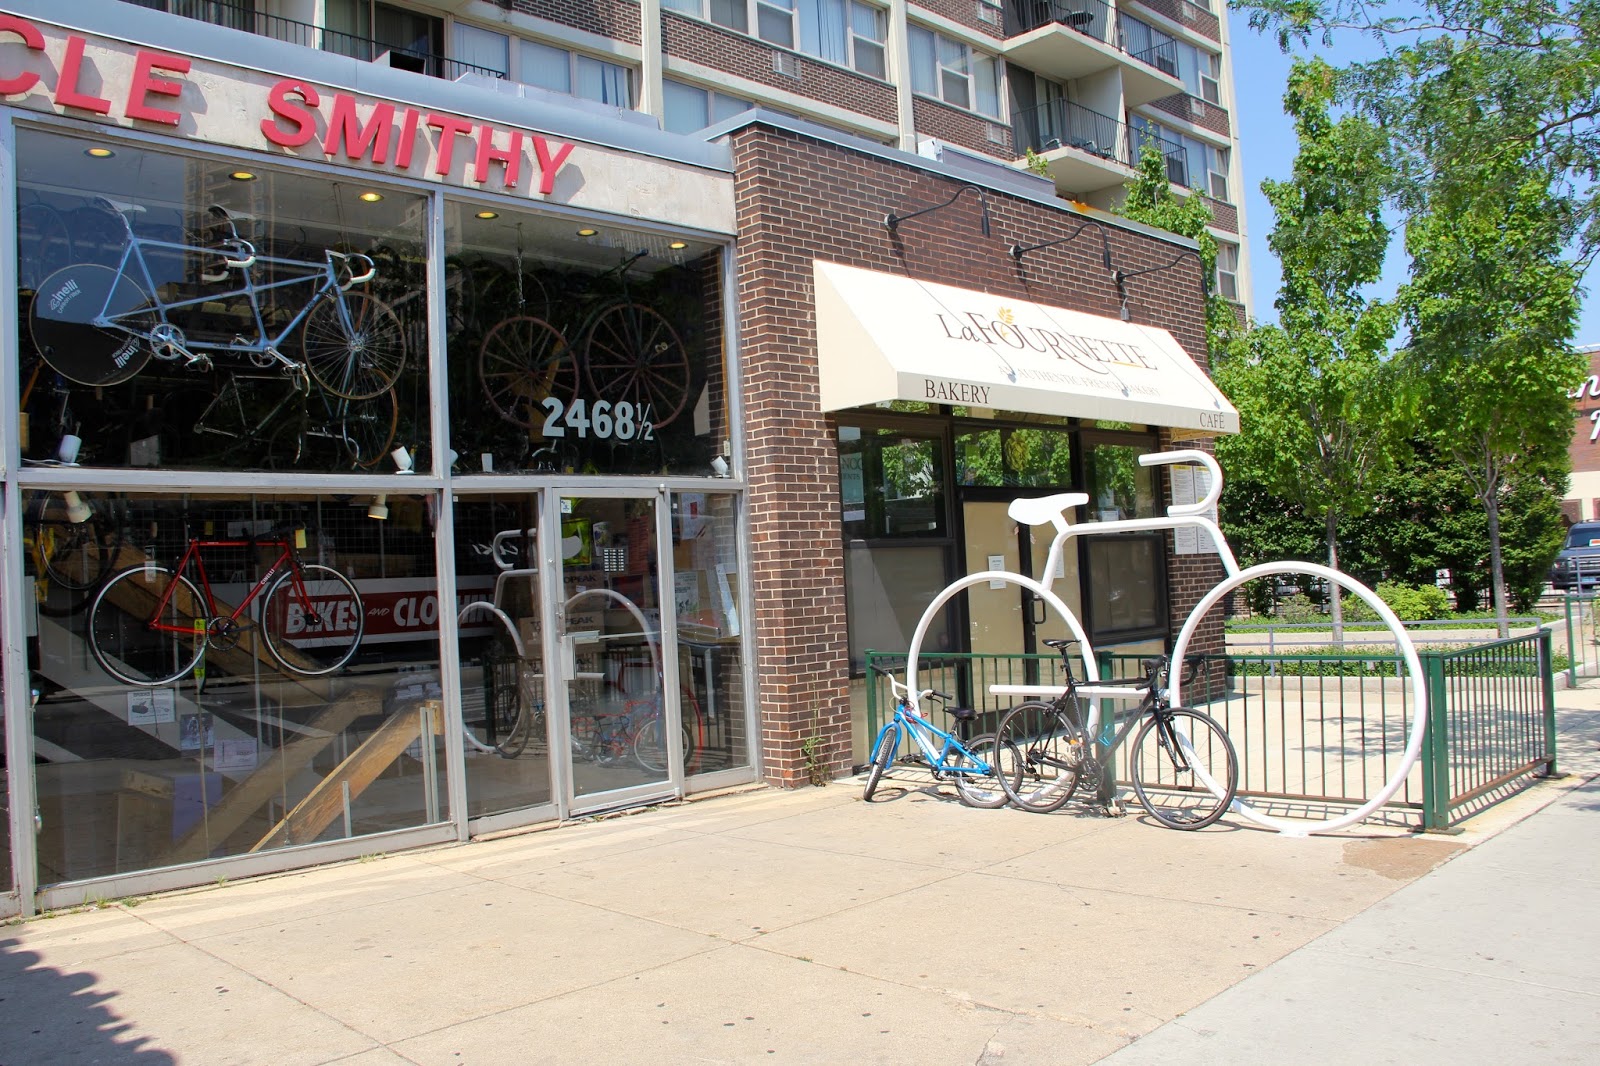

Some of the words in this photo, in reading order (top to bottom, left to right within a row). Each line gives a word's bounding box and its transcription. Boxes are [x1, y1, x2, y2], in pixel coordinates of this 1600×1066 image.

[260, 79, 577, 194] SMITHY
[1017, 367, 1081, 385] AUTHENTIC
[924, 378, 991, 405] BAKERY
[1199, 412, 1225, 430] CAFÉ
[260, 568, 275, 585] CINELLI
[564, 575, 596, 584] OPEAK
[286, 601, 365, 634] BIKES
[367, 607, 390, 617] AND
